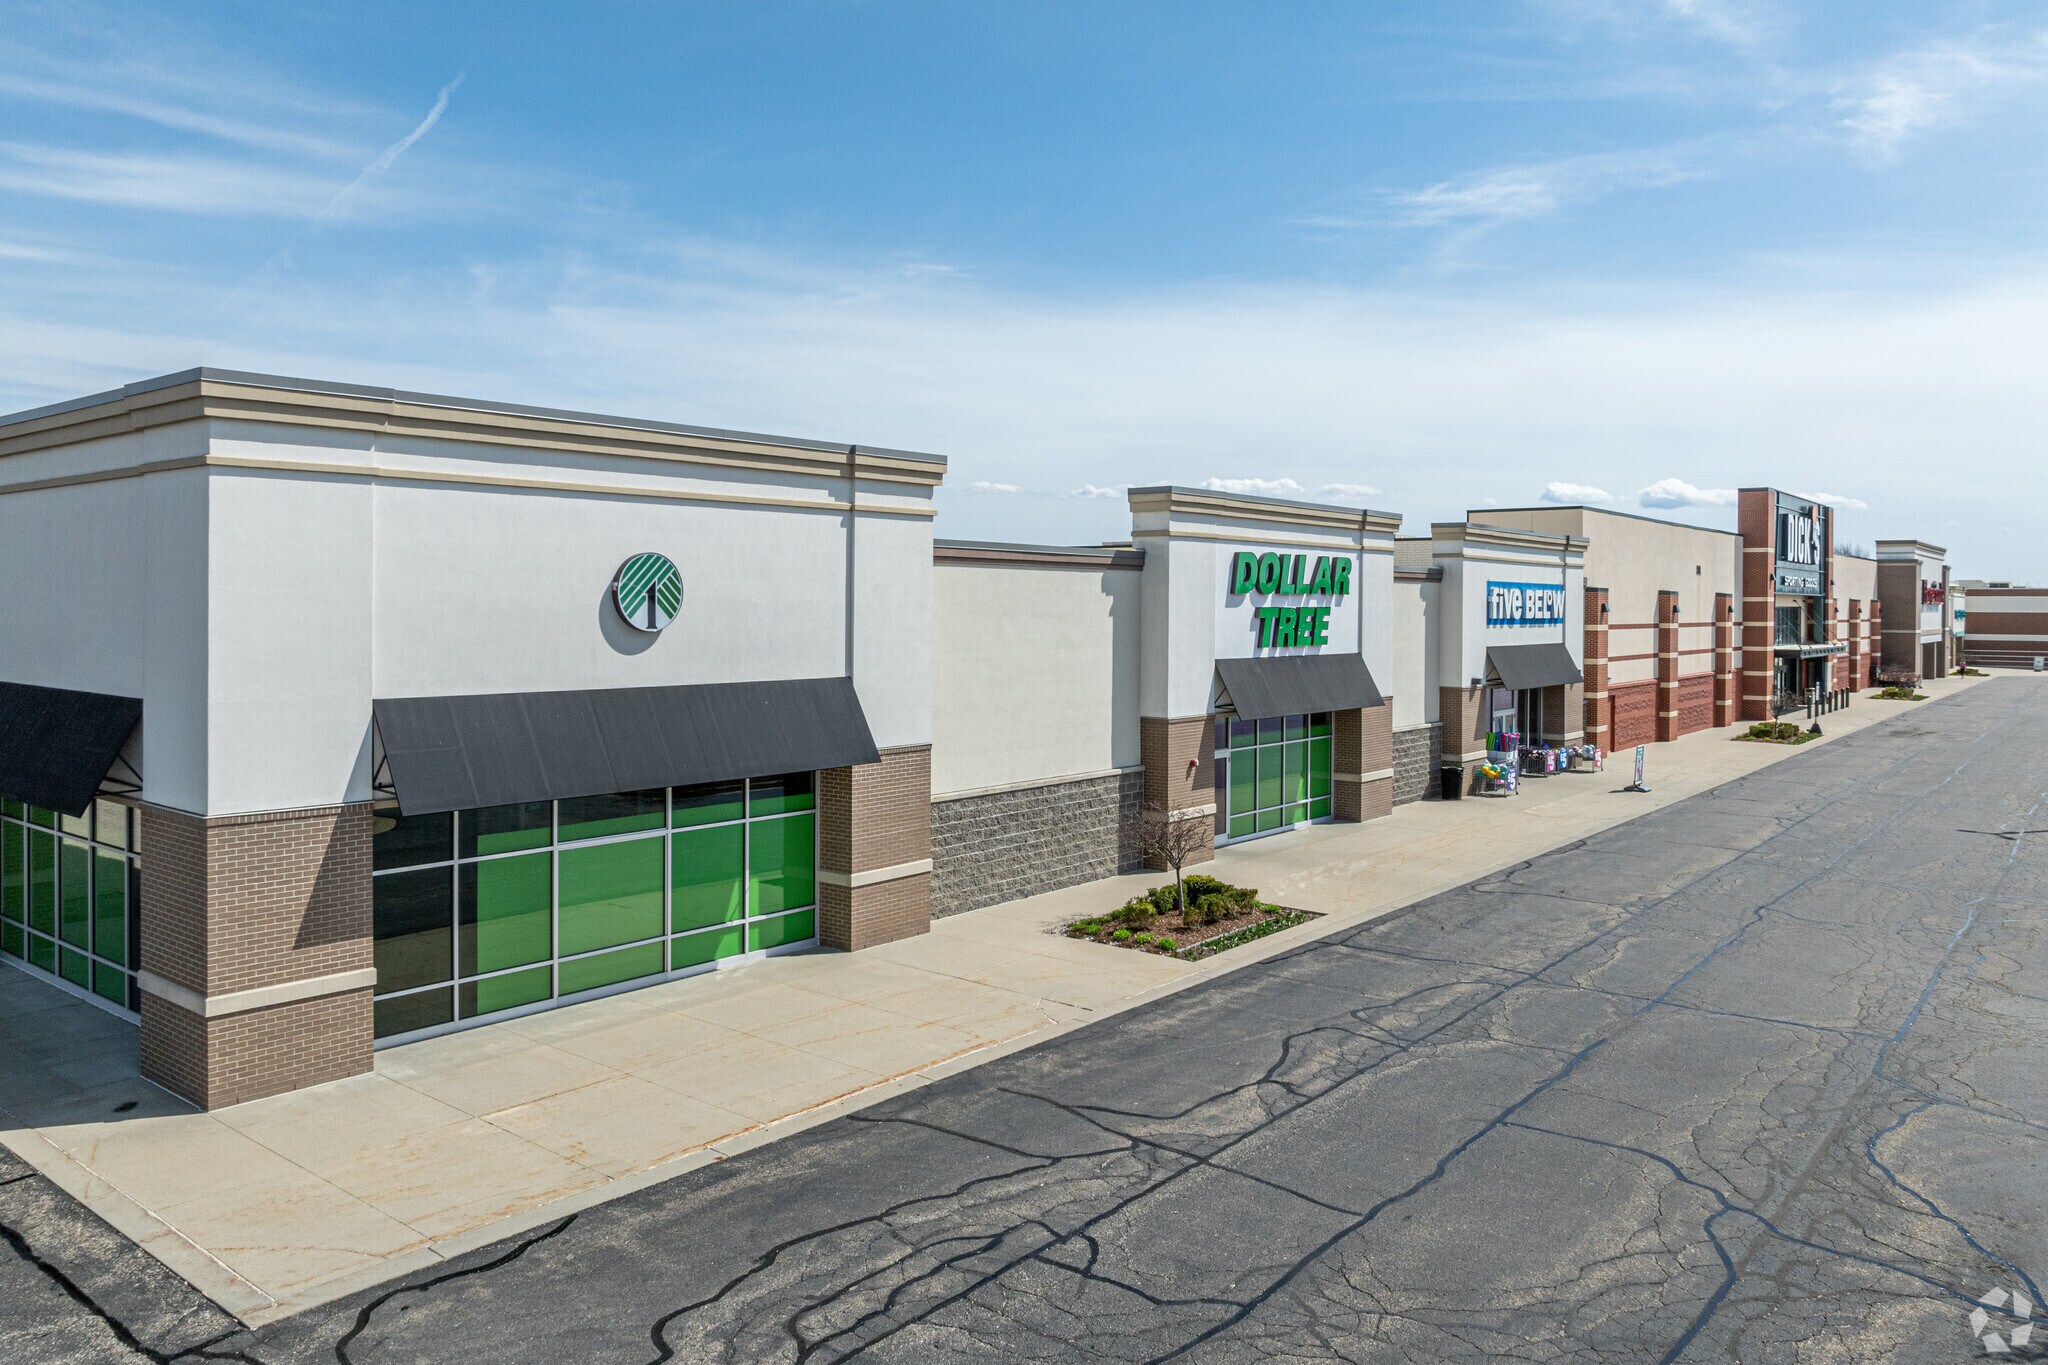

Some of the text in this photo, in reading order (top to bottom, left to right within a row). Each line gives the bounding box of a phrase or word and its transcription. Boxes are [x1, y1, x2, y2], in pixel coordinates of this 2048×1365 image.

[1786, 505, 1820, 565] DICK'S
[1231, 552, 1352, 595] DOLLAR
[1784, 575, 1804, 587] SPORTNG
[1490, 587, 1522, 619] five
[1256, 607, 1331, 648] TREE
[1507, 772, 1516, 790] $5
